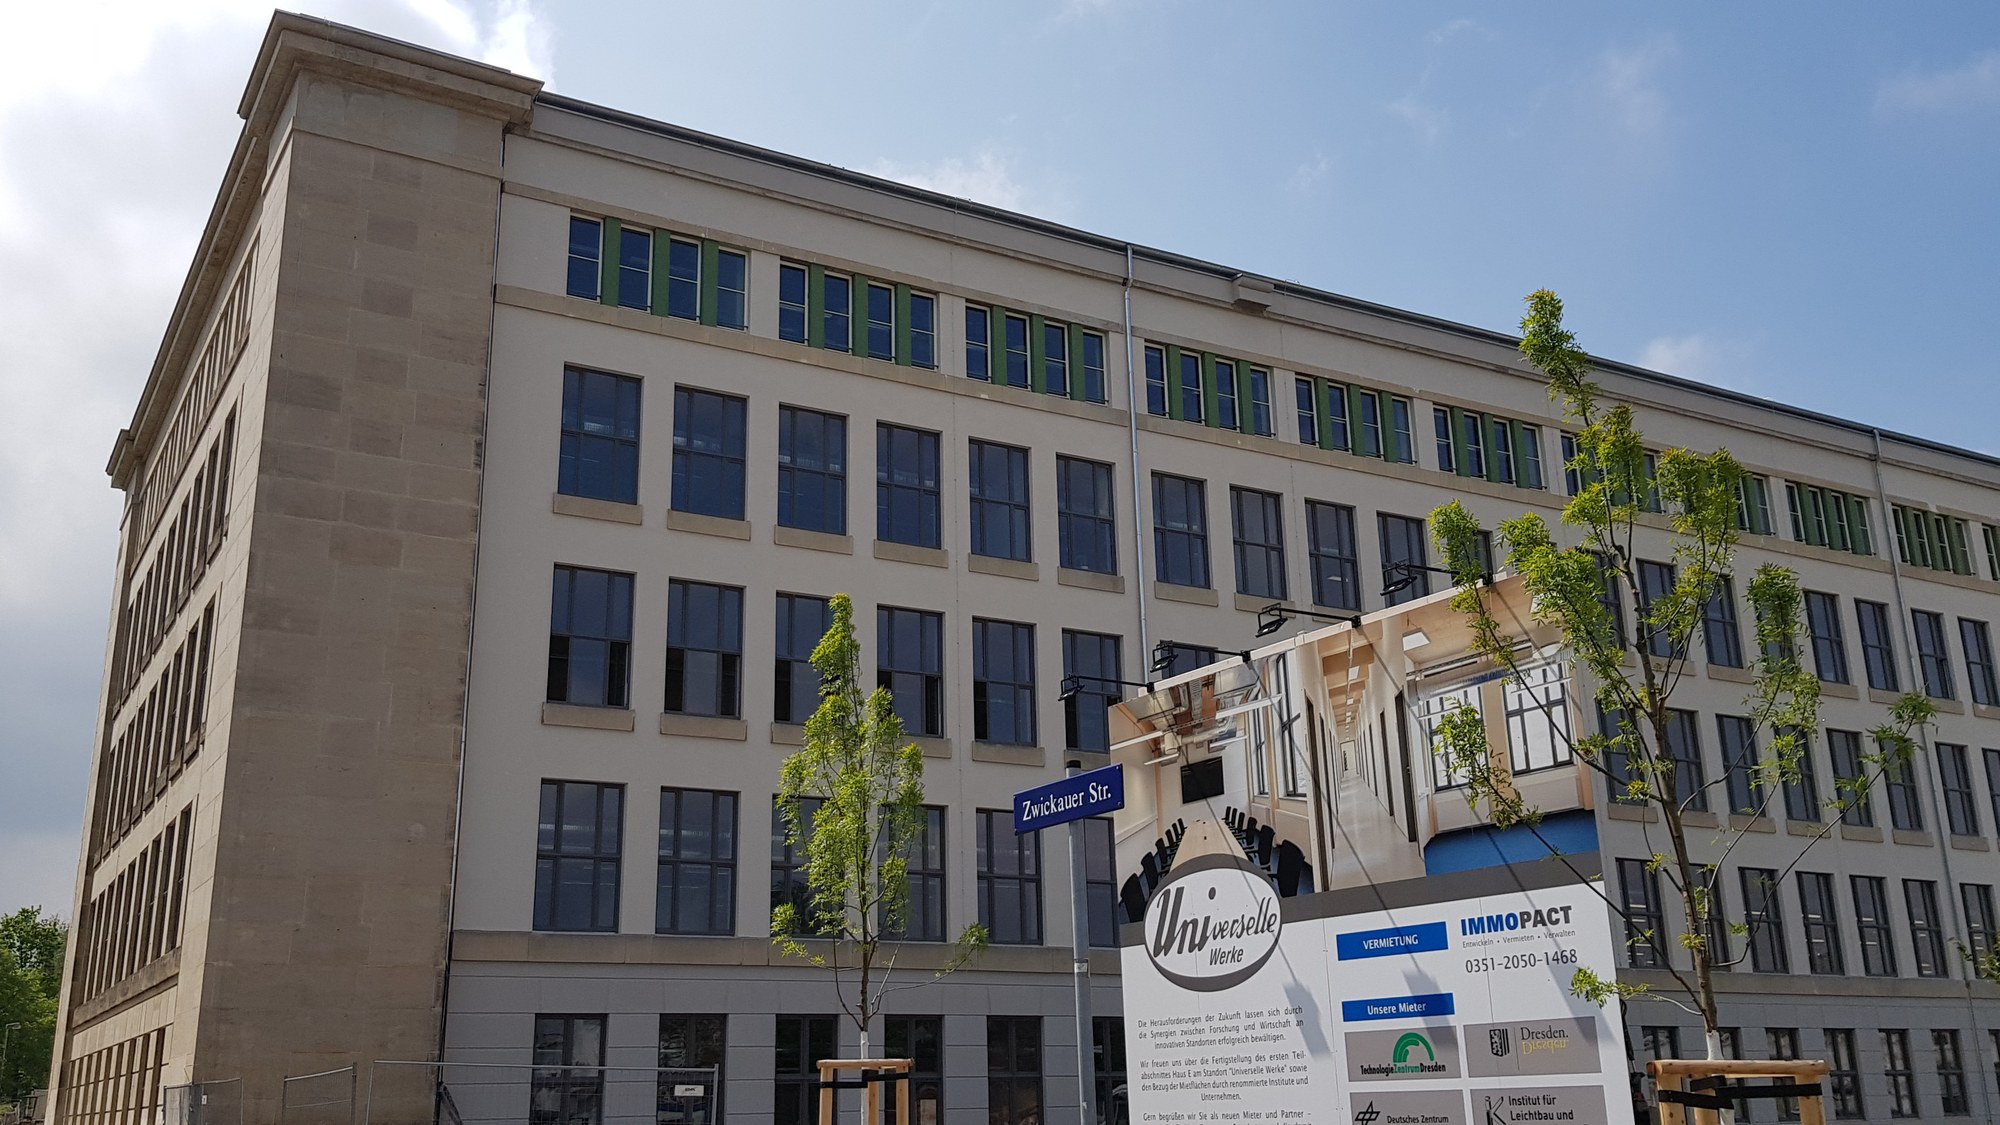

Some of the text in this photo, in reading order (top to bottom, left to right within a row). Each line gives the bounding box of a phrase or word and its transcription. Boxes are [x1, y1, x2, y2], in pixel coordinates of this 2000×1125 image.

[1022, 782, 1112, 821] Zwickauer Str.
[1153, 886, 1277, 958] Universelle
[1460, 905, 1572, 936] IMMOPACT
[1363, 934, 1419, 950] VERMIETUNG
[1462, 929, 1576, 949] Entwickeln Vermieten Verwalten
[1209, 945, 1244, 966] Werke
[1465, 948, 1578, 974] 0351-2050-1468
[1138, 1005, 1303, 1028] Die Herausforderungen der Zukunft lassen sich durch
[1367, 1002, 1427, 1016] Unsere Mieter
[1138, 1018, 1304, 1040] die Synergien zwischen Forschung und Wirtschaft an
[1520, 1025, 1569, 1041] Dresden.
[1154, 1041, 1185, 1050] innovativen
[1186, 1038, 1217, 1048] Standorten
[1218, 1035, 1250, 1046] erfolgreich
[1140, 1050, 1307, 1068] Wir freuen uns über die Fertigstellung des ersten Teil-
[1172, 1070, 1187, 1078] Haus
[1187, 1069, 1192, 1078] E
[1193, 1070, 1202, 1078] am
[1203, 1068, 1228, 1077] Standort
[1289, 1063, 1308, 1073] sowie
[1360, 1061, 1447, 1076] TechnologieZentrumDresden
[1141, 1083, 1152, 1092] den
[1152, 1082, 1169, 1092] Bezug
[1169, 1082, 1179, 1090] der
[1212, 1079, 1228, 1089] durch
[1229, 1079, 1268, 1088] renommierte
[1269, 1077, 1295, 1086] Institute
[1296, 1075, 1309, 1085] und
[1200, 1092, 1242, 1101] Unternehmen.
[1508, 1094, 1556, 1106] Institut für
[1187, 1112, 1196, 1120] wir
[1198, 1111, 1207, 1120] Sie
[1210, 1111, 1219, 1120] als
[1221, 1112, 1240, 1120] neuen
[1242, 1110, 1262, 1119] Mieter
[1265, 1109, 1278, 1119] und
[1281, 1109, 1304, 1119] Partner
[1386, 1115, 1449, 1124] Deutsches Zentrum
[1510, 1109, 1574, 1121] Leichtbau und
